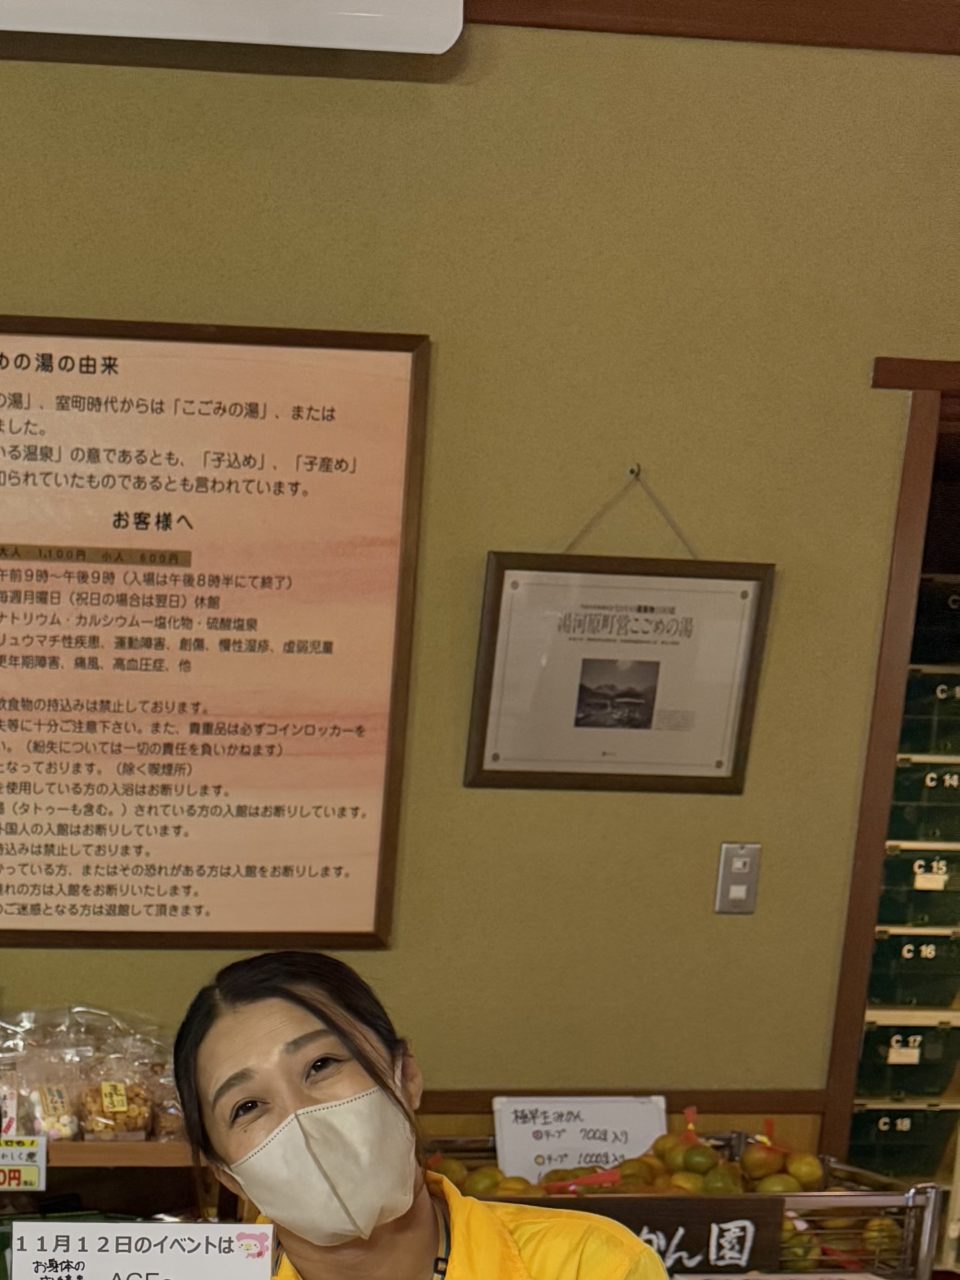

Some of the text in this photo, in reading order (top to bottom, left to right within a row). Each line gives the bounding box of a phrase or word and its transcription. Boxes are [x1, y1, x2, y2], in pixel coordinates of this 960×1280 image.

[112, 511, 194, 531] お客様へ
[925, 773, 959, 788] C 14
[913, 860, 947, 875] C 15
[901, 944, 937, 959] C 16
[891, 1035, 923, 1048] C 17
[878, 1117, 911, 1132] C 18
[16, 1234, 235, 1255] 11月12日のイベントは
[639, 1219, 755, 1268] かん園
